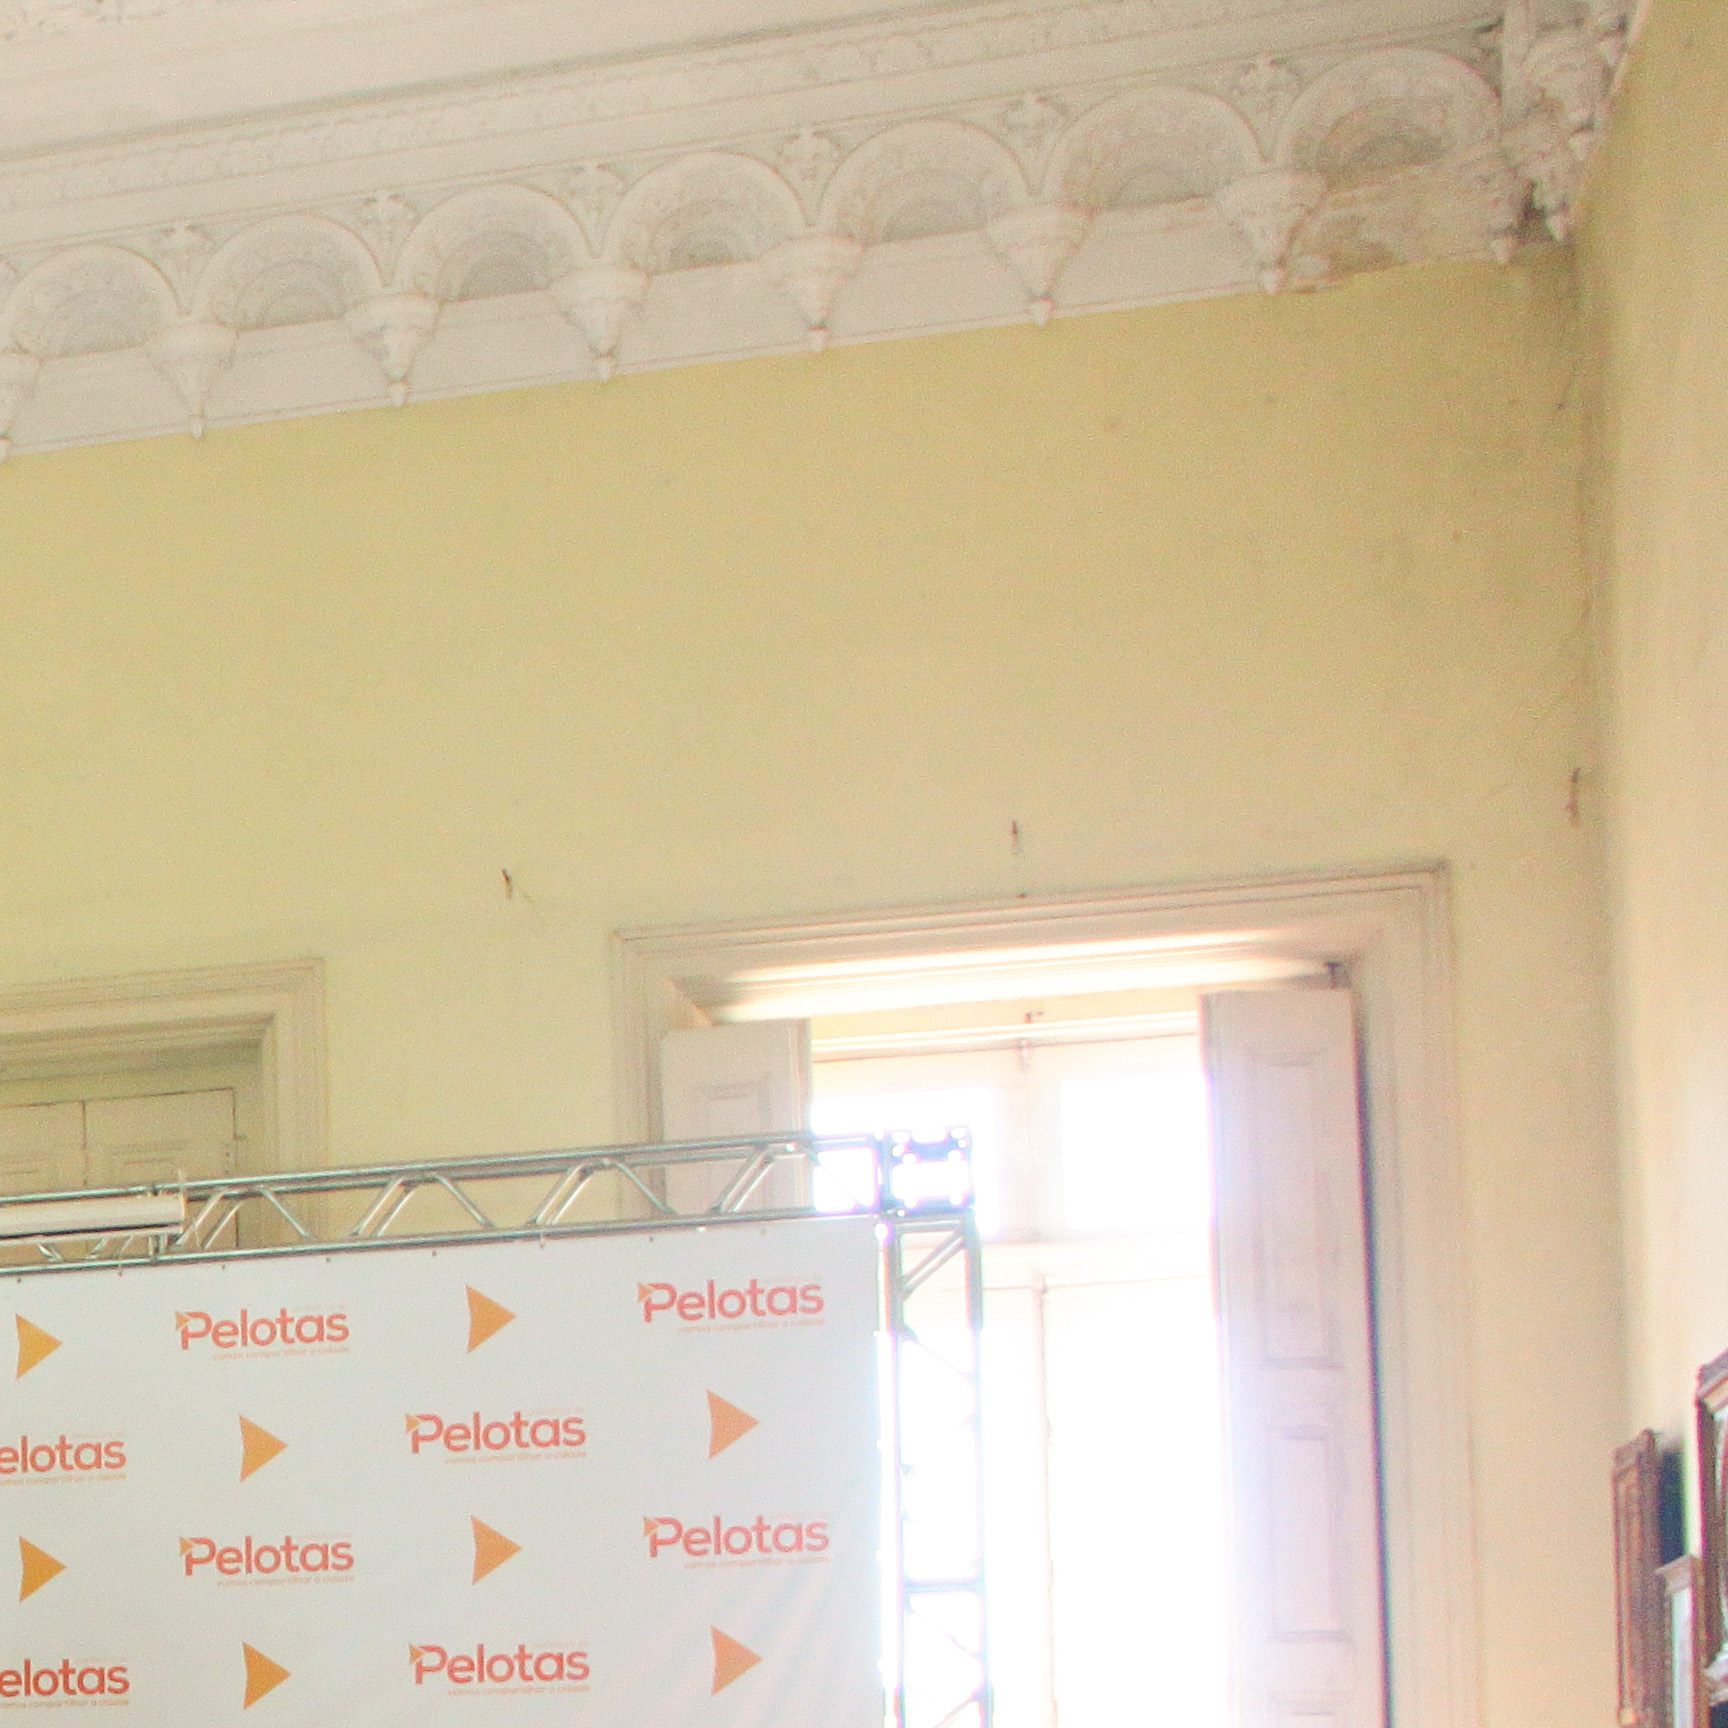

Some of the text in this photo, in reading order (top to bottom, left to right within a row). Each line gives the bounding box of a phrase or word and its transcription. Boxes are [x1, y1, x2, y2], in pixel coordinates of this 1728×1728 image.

[638, 1278, 824, 1323] Pelotas
[175, 1308, 349, 1349] Pelotas
[405, 1411, 587, 1453] Pelotas
[179, 1535, 355, 1577] Pelotas
[644, 1515, 830, 1557] Pelotas
[409, 1643, 591, 1685] Pelotas
